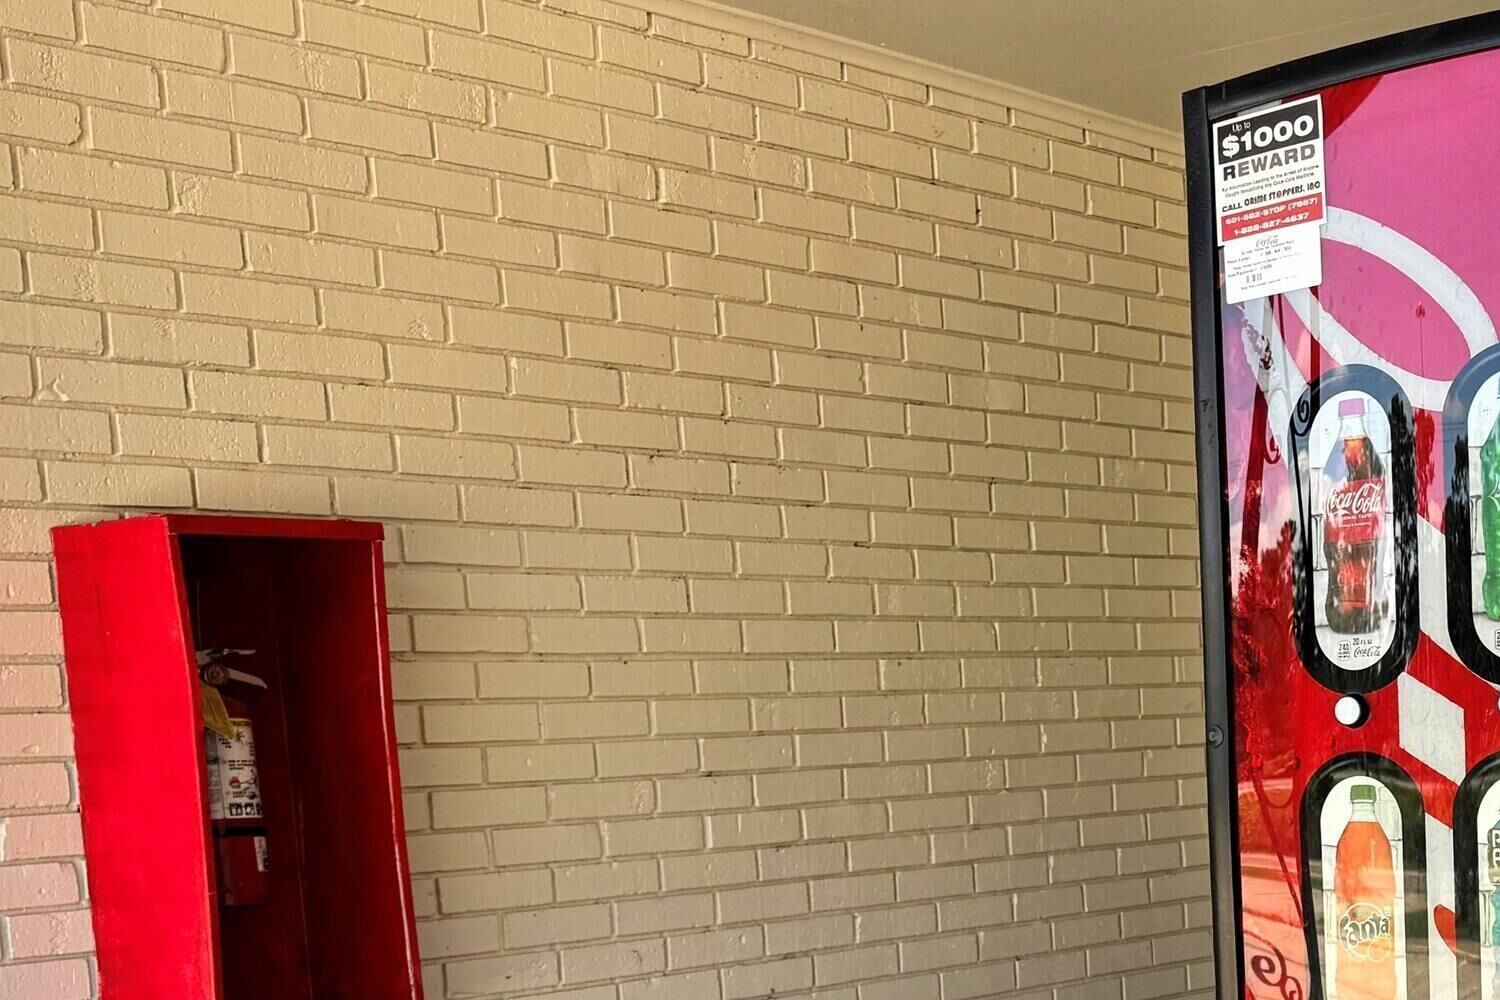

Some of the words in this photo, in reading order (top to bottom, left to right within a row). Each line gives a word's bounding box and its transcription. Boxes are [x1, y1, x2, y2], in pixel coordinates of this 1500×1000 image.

[1222, 115, 1314, 159] $1000
[1232, 124, 1243, 133] Up
[1243, 121, 1251, 129] to
[1223, 144, 1315, 181] REWARD
[1222, 202, 1243, 213] CALL
[1339, 911, 1391, 952] Fanta
